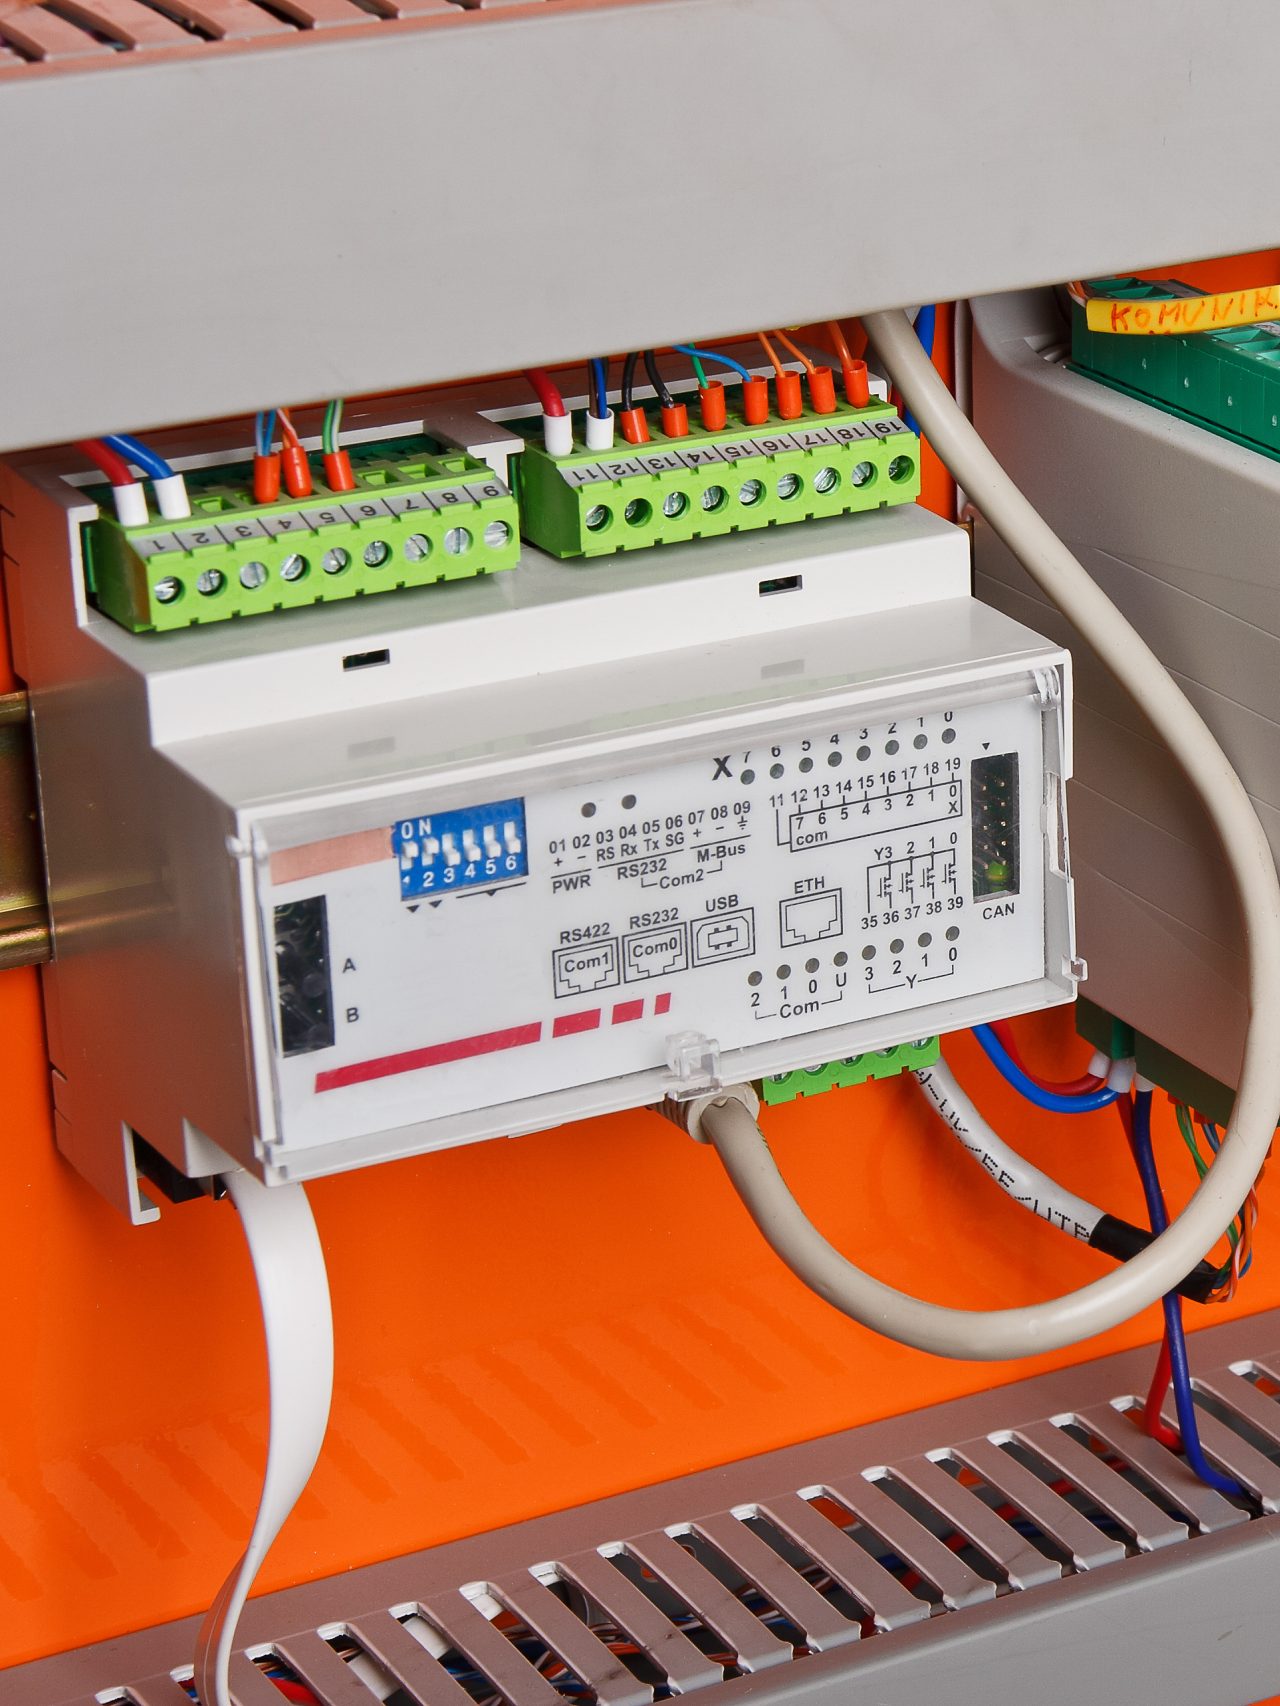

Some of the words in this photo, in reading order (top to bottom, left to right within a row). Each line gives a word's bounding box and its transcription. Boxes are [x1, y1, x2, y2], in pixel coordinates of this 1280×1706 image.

[712, 754, 733, 781] X
[769, 794, 784, 808] 11
[791, 789, 808, 803] 12
[813, 784, 830, 798] 13
[836, 779, 853, 794] 14
[857, 775, 875, 789] 15
[879, 770, 897, 784] 16
[901, 766, 918, 780] 17
[923, 761, 940, 776] 18
[945, 757, 961, 771] 19
[796, 816, 804, 830] 7
[818, 811, 827, 825] 6
[840, 806, 849, 821] 5
[862, 802, 871, 816] 4
[884, 797, 893, 811] 3
[906, 793, 915, 807] 2
[928, 789, 935, 802] 1
[949, 784, 958, 798] 0
[401, 818, 431, 839] ON
[549, 838, 567, 853] 01
[573, 834, 591, 849] 02
[596, 829, 614, 844] 03
[619, 824, 637, 839] 04
[642, 819, 660, 834] 05
[665, 814, 683, 830] 06
[688, 809, 706, 825] 07
[710, 805, 728, 820] 08
[733, 800, 751, 815] 09
[796, 829, 828, 846] com
[948, 801, 959, 814] X
[596, 846, 615, 862] RS
[621, 842, 638, 856] Rx
[643, 836, 660, 851] Tx
[665, 831, 685, 847] SG
[697, 842, 745, 864] M-Bus
[873, 845, 894, 861] Y3
[907, 841, 915, 855] 2
[950, 832, 958, 845] 0
[423, 871, 434, 887] 2
[444, 867, 455, 883] 3
[465, 863, 476, 878] 4
[486, 859, 496, 875] 5
[506, 855, 516, 870] 6
[617, 858, 667, 880] RS232
[659, 869, 704, 891] Com2
[553, 874, 592, 894] PWR
[793, 876, 825, 894] ETH
[706, 895, 740, 913] USB
[861, 915, 879, 930] 35
[882, 911, 900, 926] 36
[904, 905, 921, 920] 37
[926, 900, 942, 916] 38
[947, 896, 964, 911] 39
[983, 903, 1016, 921] CAN
[630, 907, 680, 930] RS232
[559, 922, 611, 945] RS422
[632, 937, 678, 958] Com0
[342, 958, 356, 973] A
[563, 952, 610, 973] Com1
[864, 966, 874, 981] 3
[892, 960, 902, 975] 2
[921, 953, 929, 968] 1
[948, 947, 958, 962] 0
[750, 992, 761, 1007] 2
[780, 986, 788, 1000] 1
[808, 979, 818, 994] 0
[835, 972, 847, 987] U
[906, 975, 917, 989] Y
[346, 1007, 359, 1023] B
[779, 998, 820, 1019] Com
